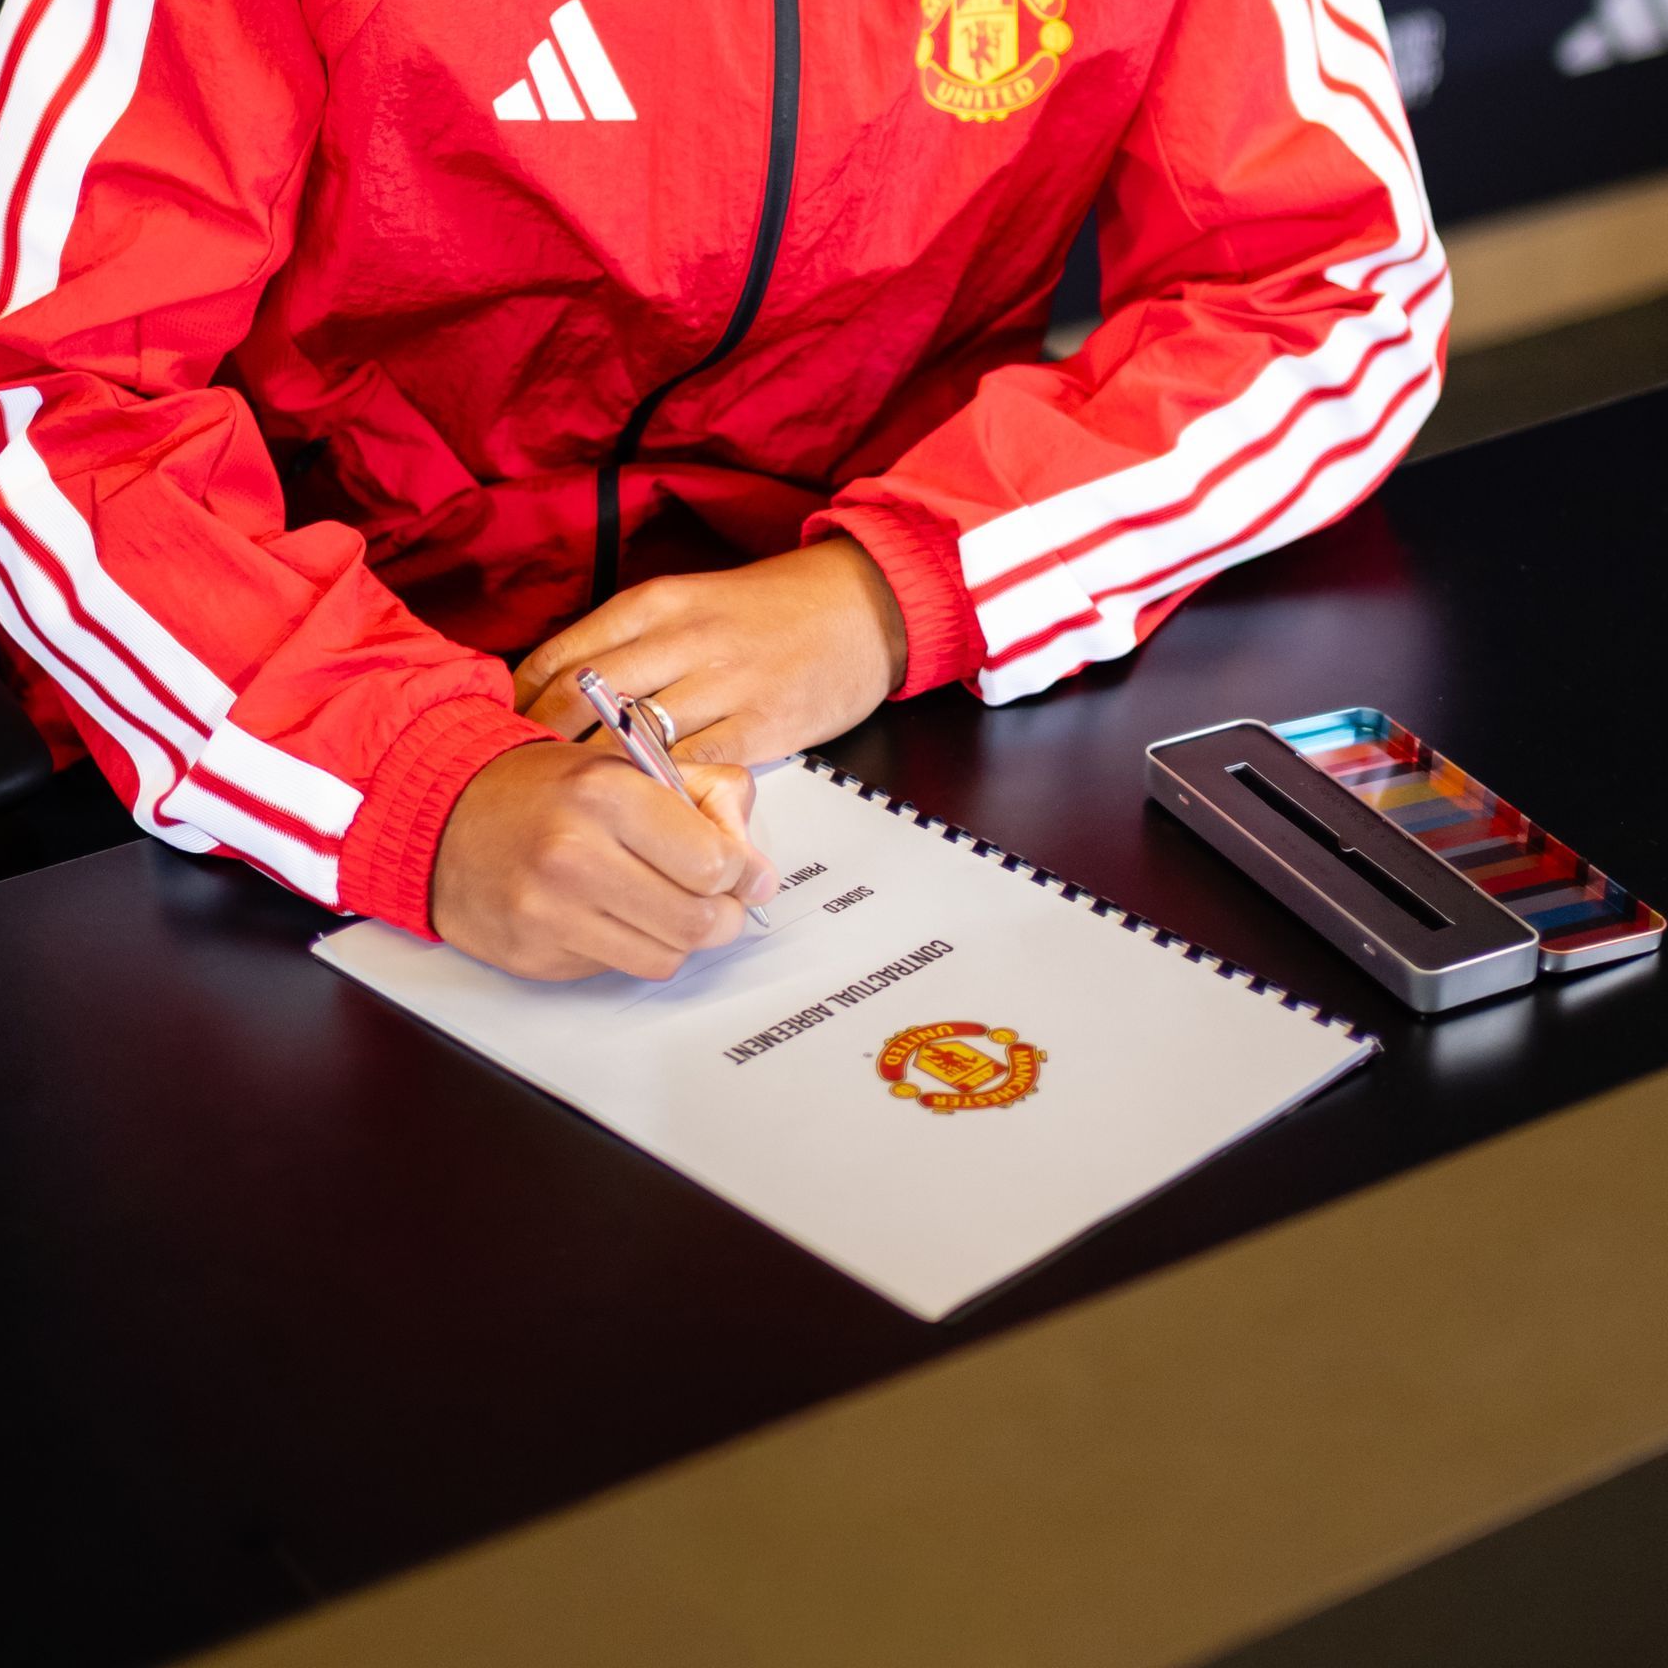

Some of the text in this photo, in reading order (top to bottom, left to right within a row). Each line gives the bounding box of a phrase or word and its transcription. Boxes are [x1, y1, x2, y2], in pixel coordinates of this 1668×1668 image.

[935, 77, 1036, 109] UNITED
[784, 862, 828, 887] PRINT
[822, 885, 874, 914] SIGNED
[723, 939, 954, 1065] CONTRACTUAL AGREEMENT
[884, 1024, 955, 1066] UNITED
[932, 1050, 1032, 1108] MANCHESTER
